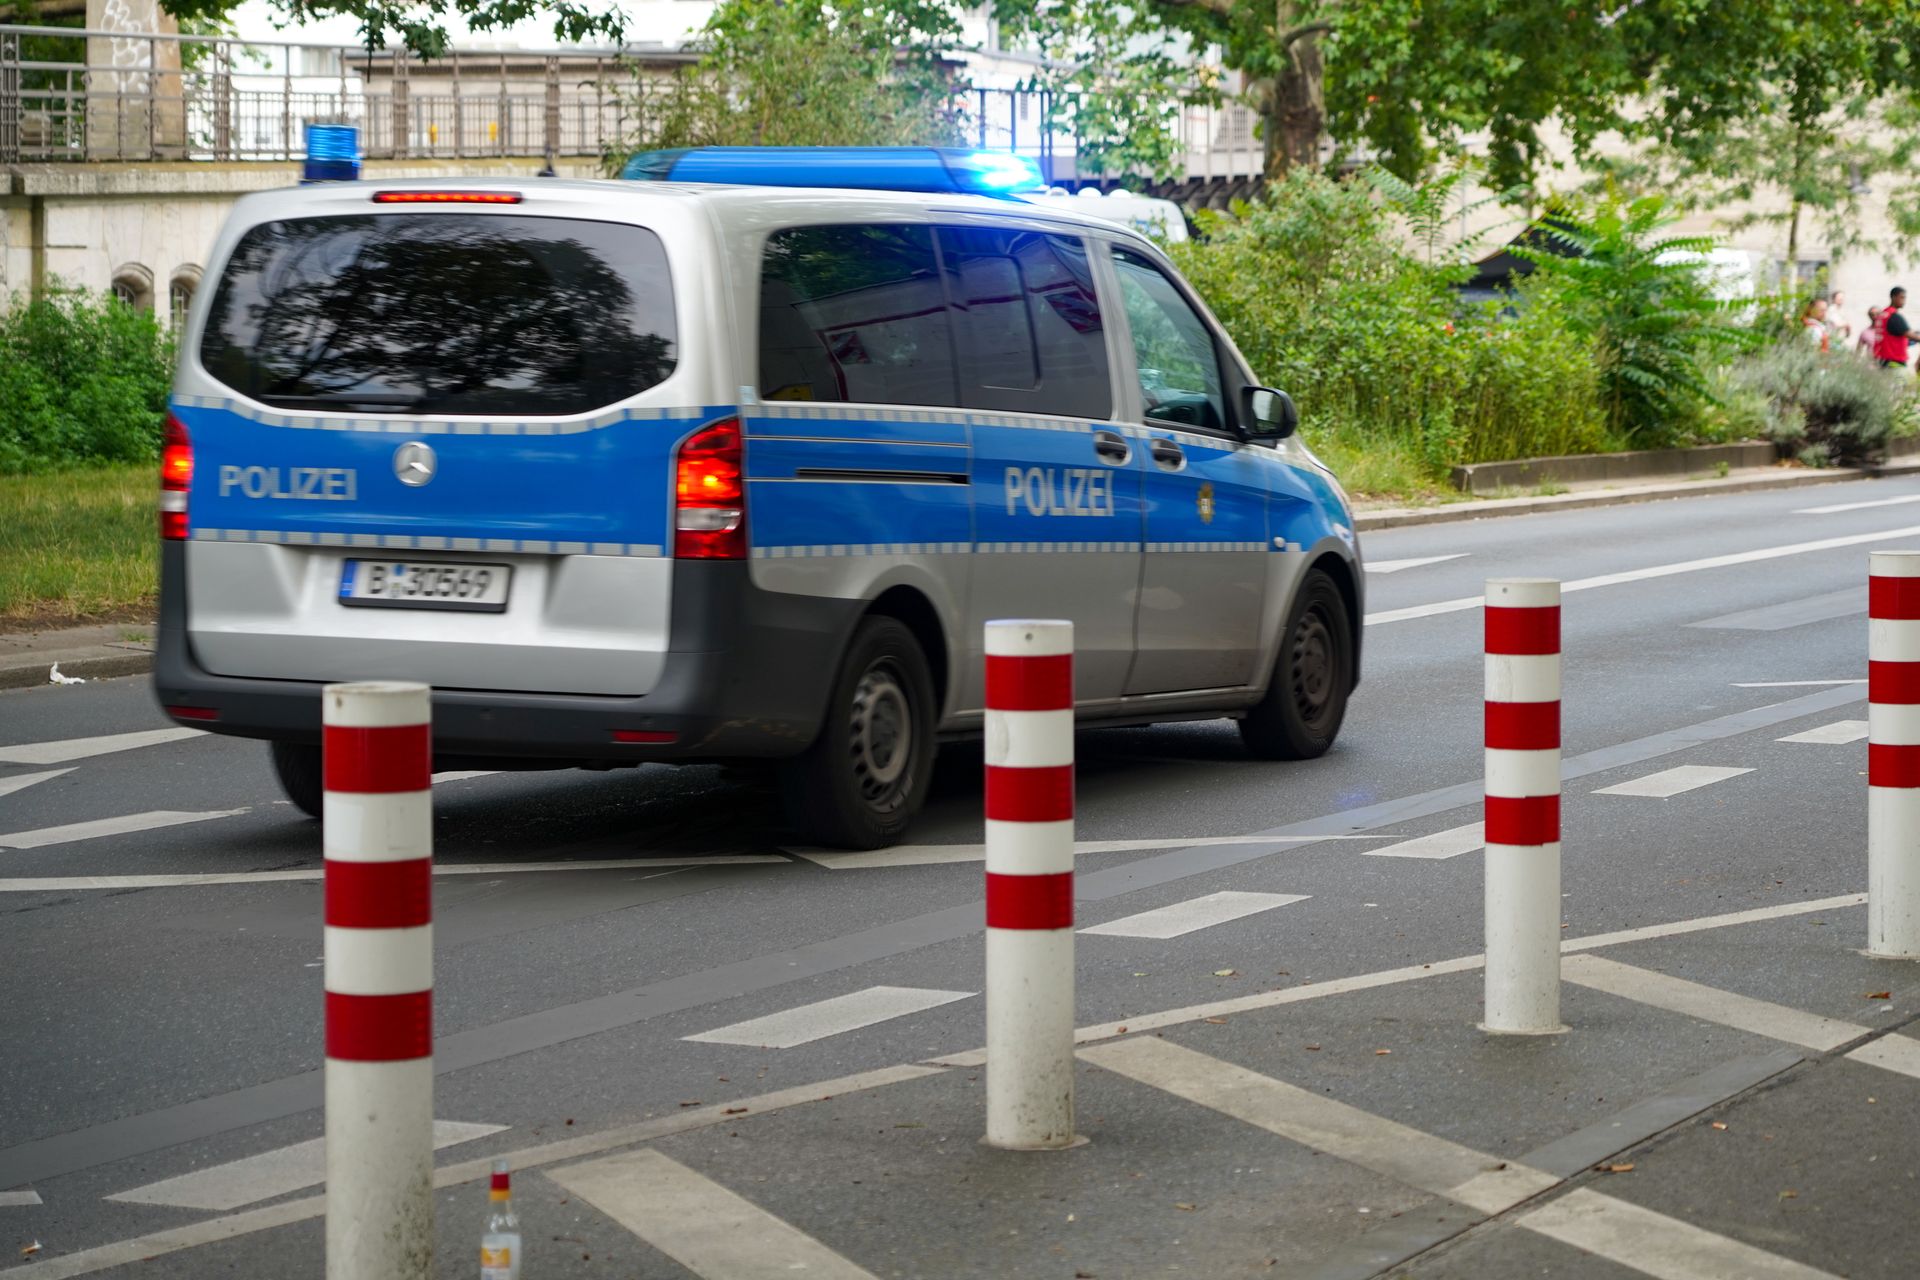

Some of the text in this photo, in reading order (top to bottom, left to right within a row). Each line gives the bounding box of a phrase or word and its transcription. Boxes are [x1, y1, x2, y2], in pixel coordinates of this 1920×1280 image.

[219, 465, 357, 500] POLIZEI
[1005, 467, 1115, 517] POLIZEI
[368, 565, 492, 599] B 30569
